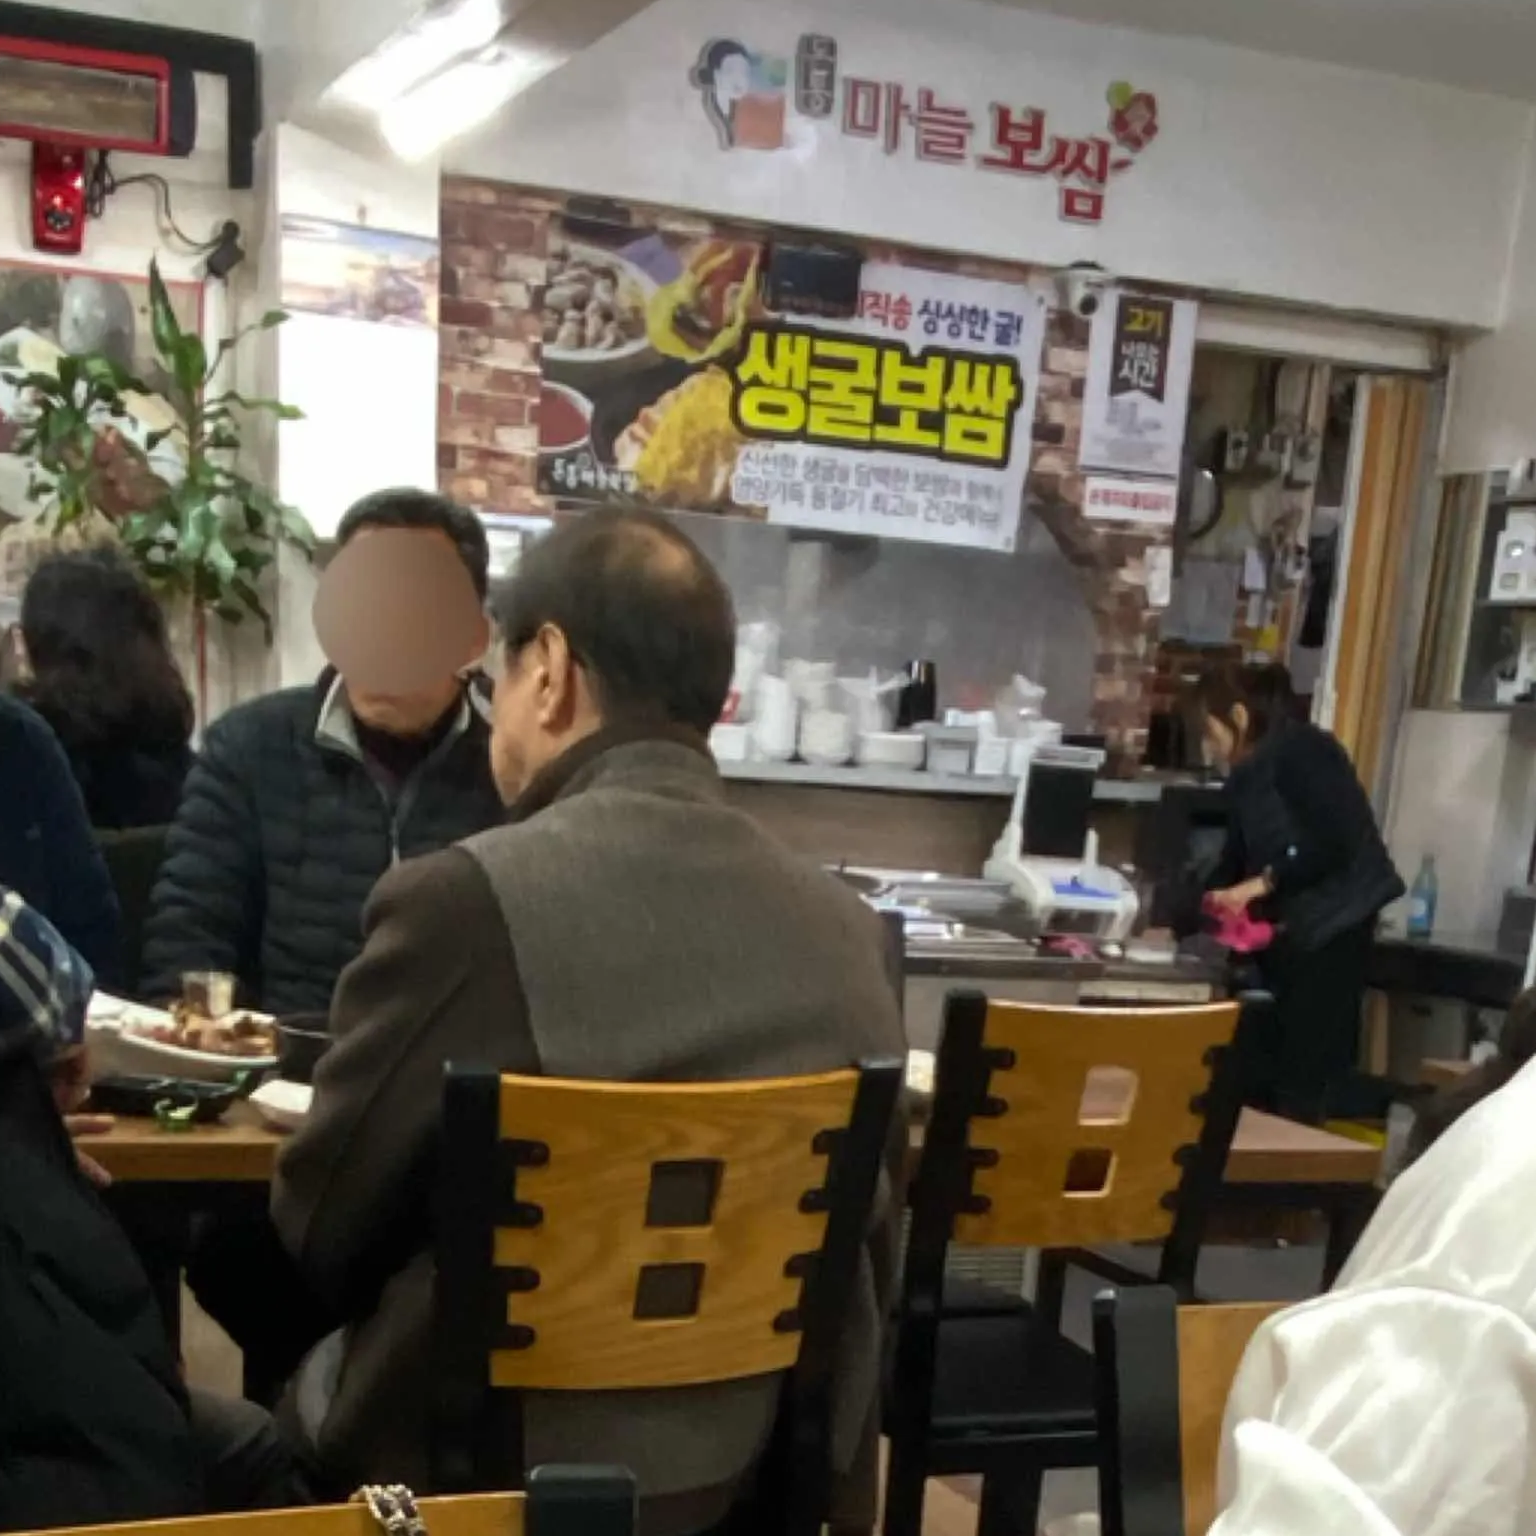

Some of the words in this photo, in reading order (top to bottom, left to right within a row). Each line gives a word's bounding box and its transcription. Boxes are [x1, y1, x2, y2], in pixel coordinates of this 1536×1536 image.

[1124, 308, 1162, 337] 고기
[1118, 358, 1158, 388] 시간
[736, 330, 1017, 460] 생굴보쌈
